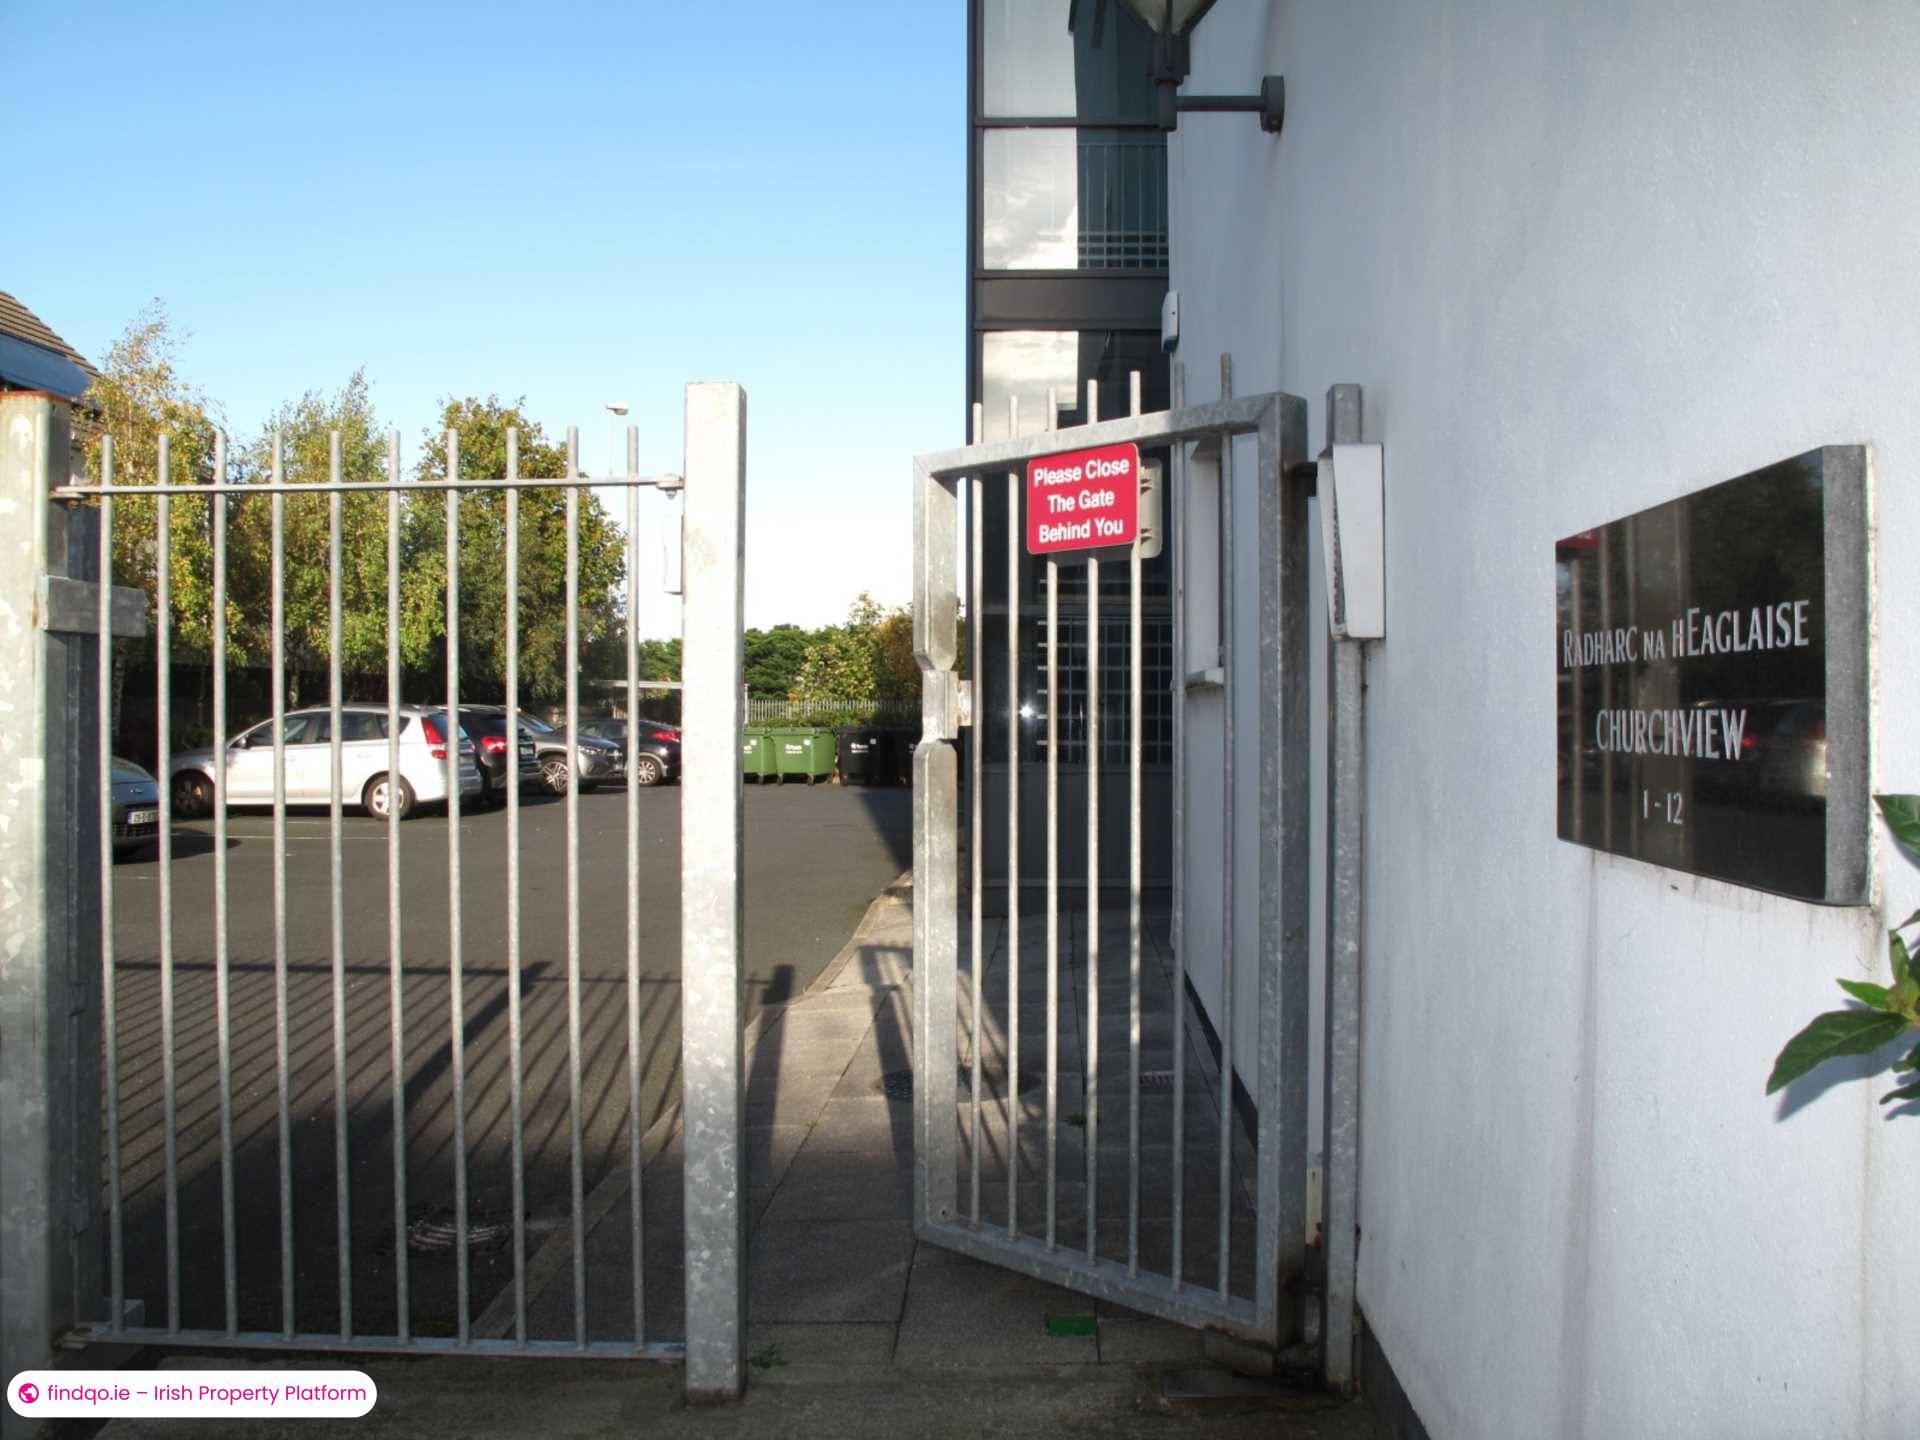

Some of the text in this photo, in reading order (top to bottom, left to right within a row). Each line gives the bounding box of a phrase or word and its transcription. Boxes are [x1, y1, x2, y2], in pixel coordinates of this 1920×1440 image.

[1034, 459, 1129, 487] Please Close
[1047, 489, 1115, 513] The Gate
[1039, 517, 1123, 543] Behind You
[1564, 626, 1638, 668] RADHARC
[1643, 631, 1665, 660] NA
[1596, 708, 1747, 760] CHURCHVIEW
[1667, 792, 1683, 824] 12
